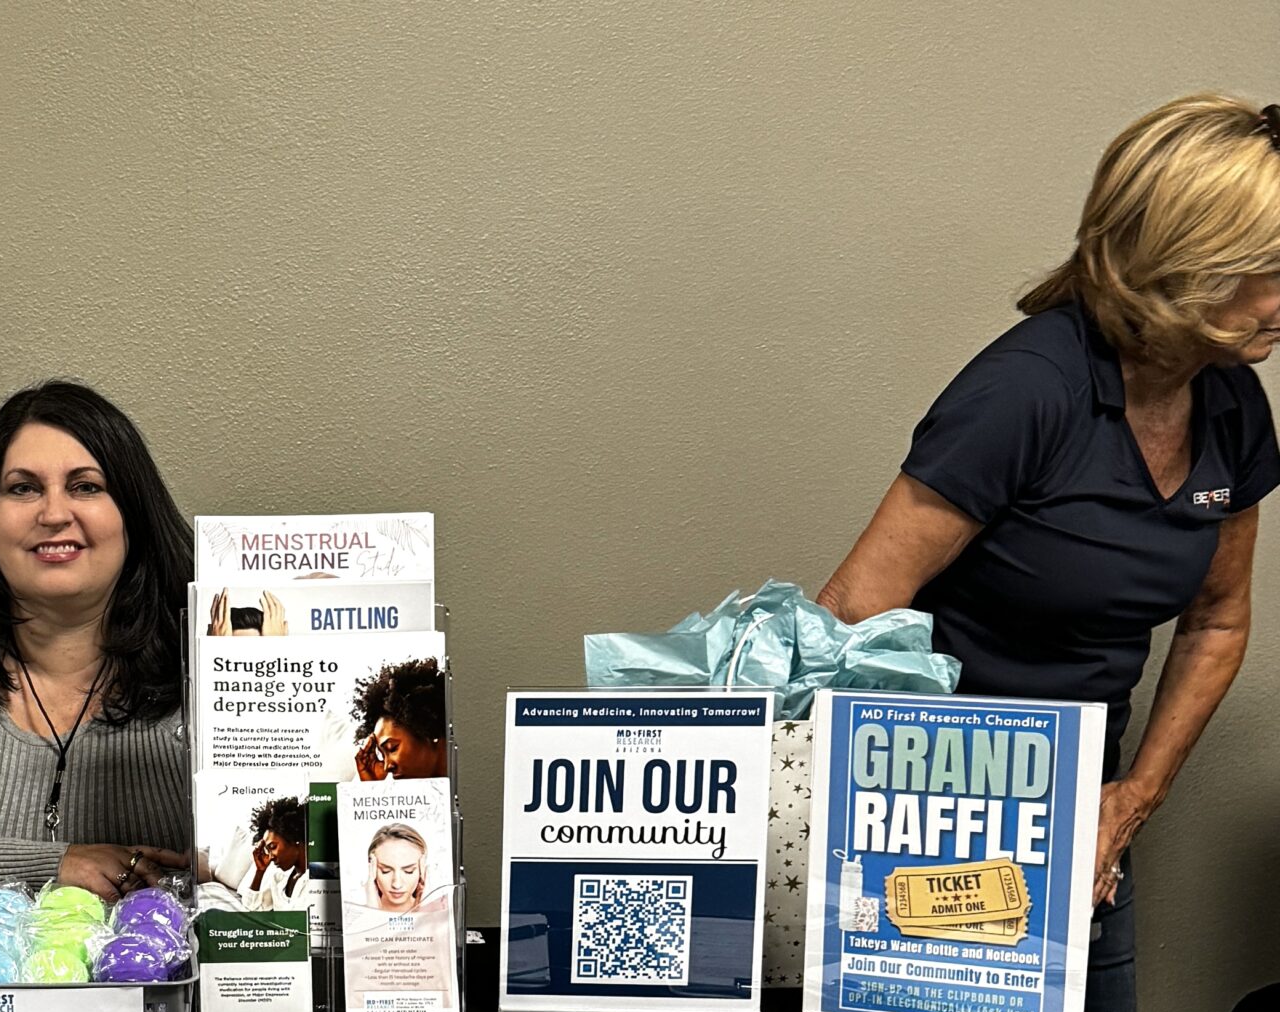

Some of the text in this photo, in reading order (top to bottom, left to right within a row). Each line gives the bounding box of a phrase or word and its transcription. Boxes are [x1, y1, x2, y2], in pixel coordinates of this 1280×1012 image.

[242, 533, 376, 550] MENSTRUAL
[242, 552, 349, 570] MIGRAINE
[311, 607, 398, 630] BATTLING
[214, 658, 338, 677] Struggling to
[214, 681, 335, 697] manage your
[214, 697, 326, 716] depression?
[523, 708, 760, 717] Advancing Medicine, Innovating Tomorrow!
[852, 723, 1051, 799] GRAND
[232, 786, 275, 795] Reliance
[524, 759, 737, 813] JOIN OUR
[353, 795, 430, 807] MENSTRUAL
[354, 809, 416, 820] MIGRAINE
[853, 791, 1047, 865] RAFFLE
[540, 819, 727, 859] community
[926, 874, 982, 893] TICKET
[931, 901, 986, 915] ADMIT ONE
[218, 940, 290, 950] your depression?
[848, 958, 1040, 988] Join Our Community to Enter
